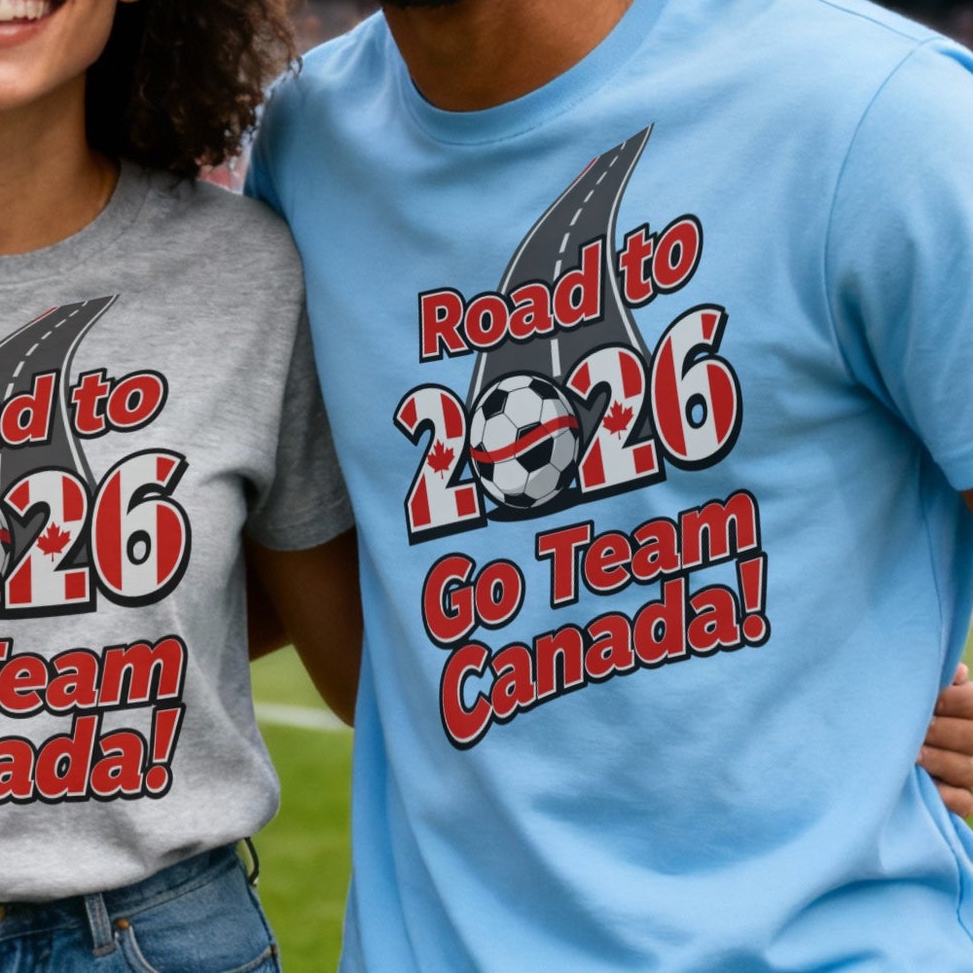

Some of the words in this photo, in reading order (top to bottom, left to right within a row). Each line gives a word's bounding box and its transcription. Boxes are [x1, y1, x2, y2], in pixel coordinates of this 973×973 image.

[418, 240, 604, 363] Road
[618, 213, 703, 308] to
[71, 368, 168, 439] to
[421, 553, 525, 649] Go
[536, 489, 761, 609] Team
[439, 554, 771, 751] Canada!
